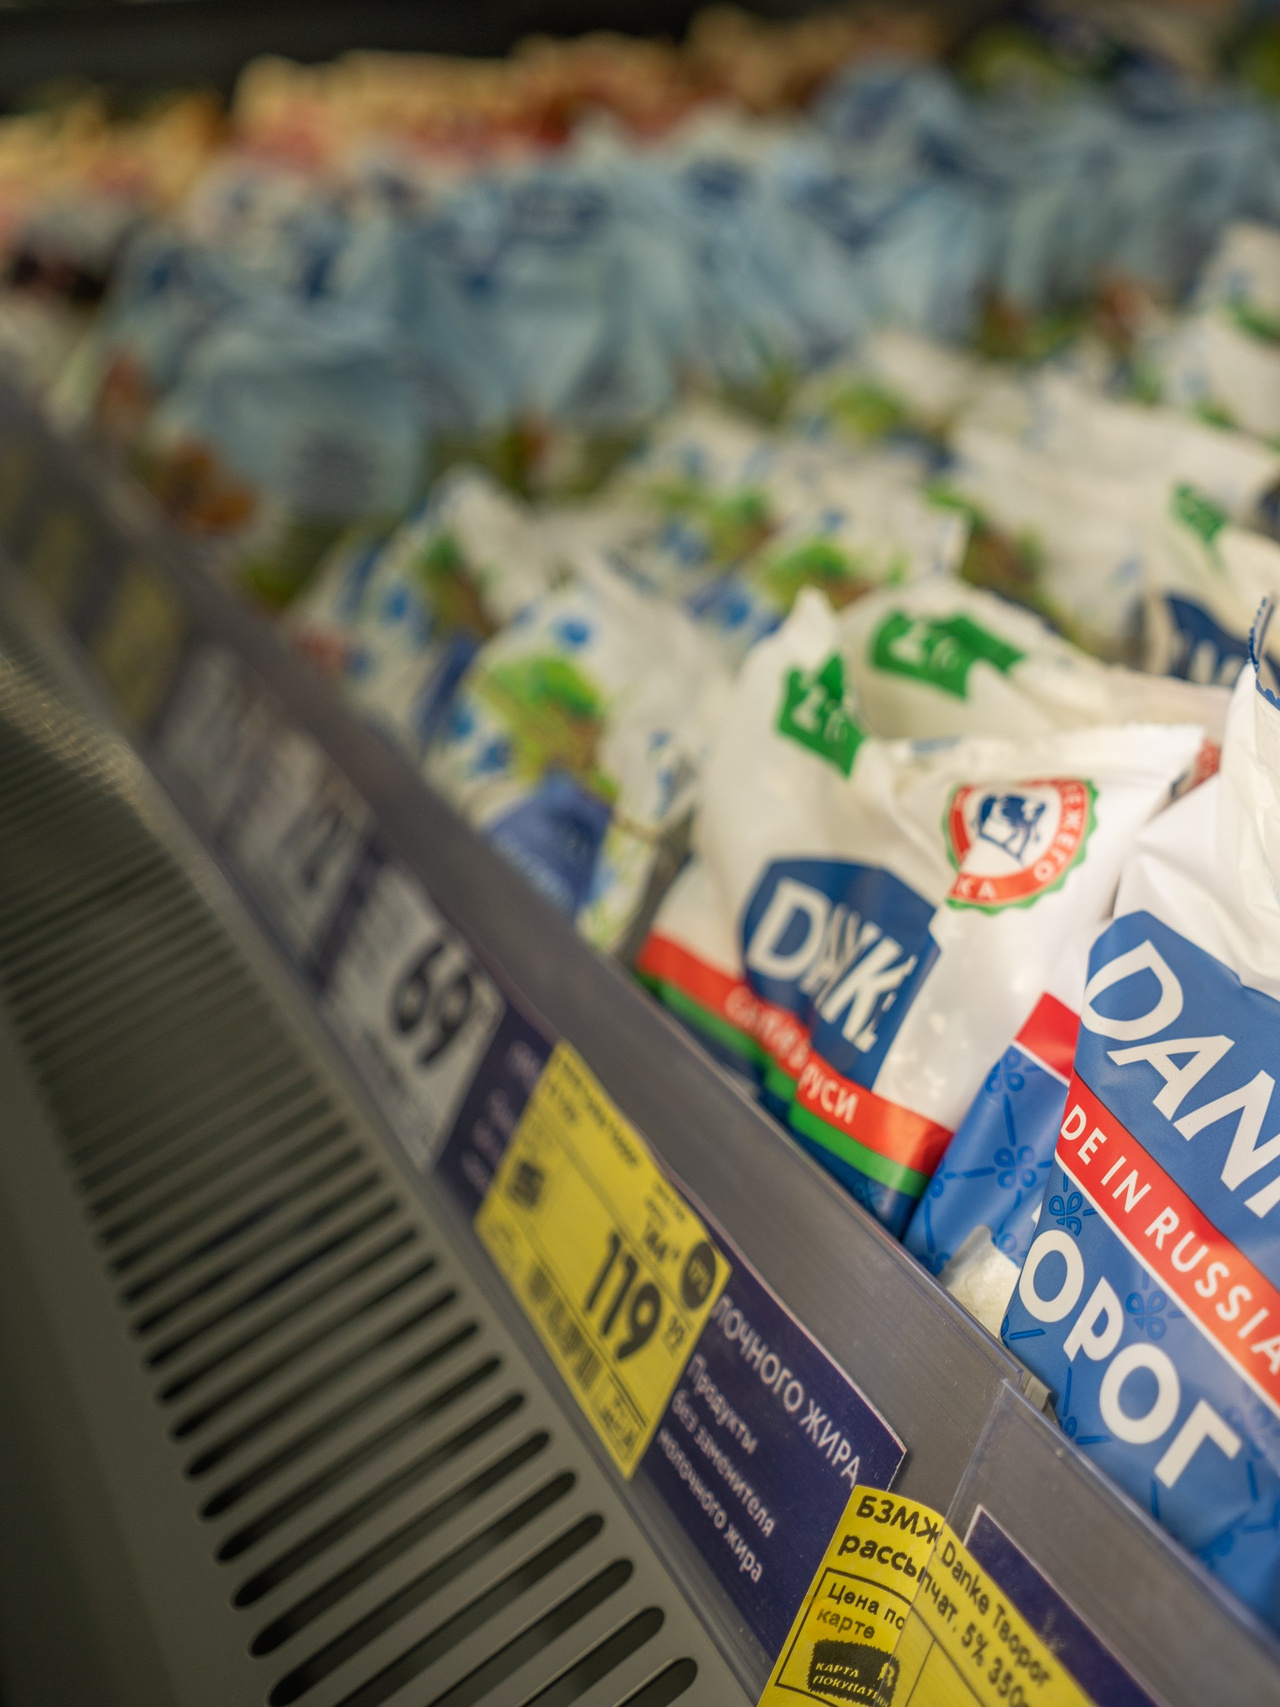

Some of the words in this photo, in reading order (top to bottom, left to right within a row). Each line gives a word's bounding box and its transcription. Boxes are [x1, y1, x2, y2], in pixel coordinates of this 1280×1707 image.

[1060, 1104, 1107, 1165] DE
[1101, 1156, 1151, 1213] IN
[583, 1230, 663, 1362] 119
[687, 1354, 758, 1454] Продукты
[799, 1399, 860, 1489] ЖИРА
[656, 1427, 728, 1530] молочного
[723, 1523, 763, 1584] жира
[672, 1390, 699, 1433] без
[693, 1425, 775, 1538] заменителя
[817, 1608, 875, 1640] карте
[828, 1582, 879, 1616] Цена
[884, 1608, 906, 1631] по
[856, 1495, 943, 1552] БЗМЖ
[941, 1540, 990, 1615] Danke
[992, 1604, 1051, 1688] Творог
[815, 1663, 859, 1678] КАРТА
[961, 1622, 988, 1668] 5%
